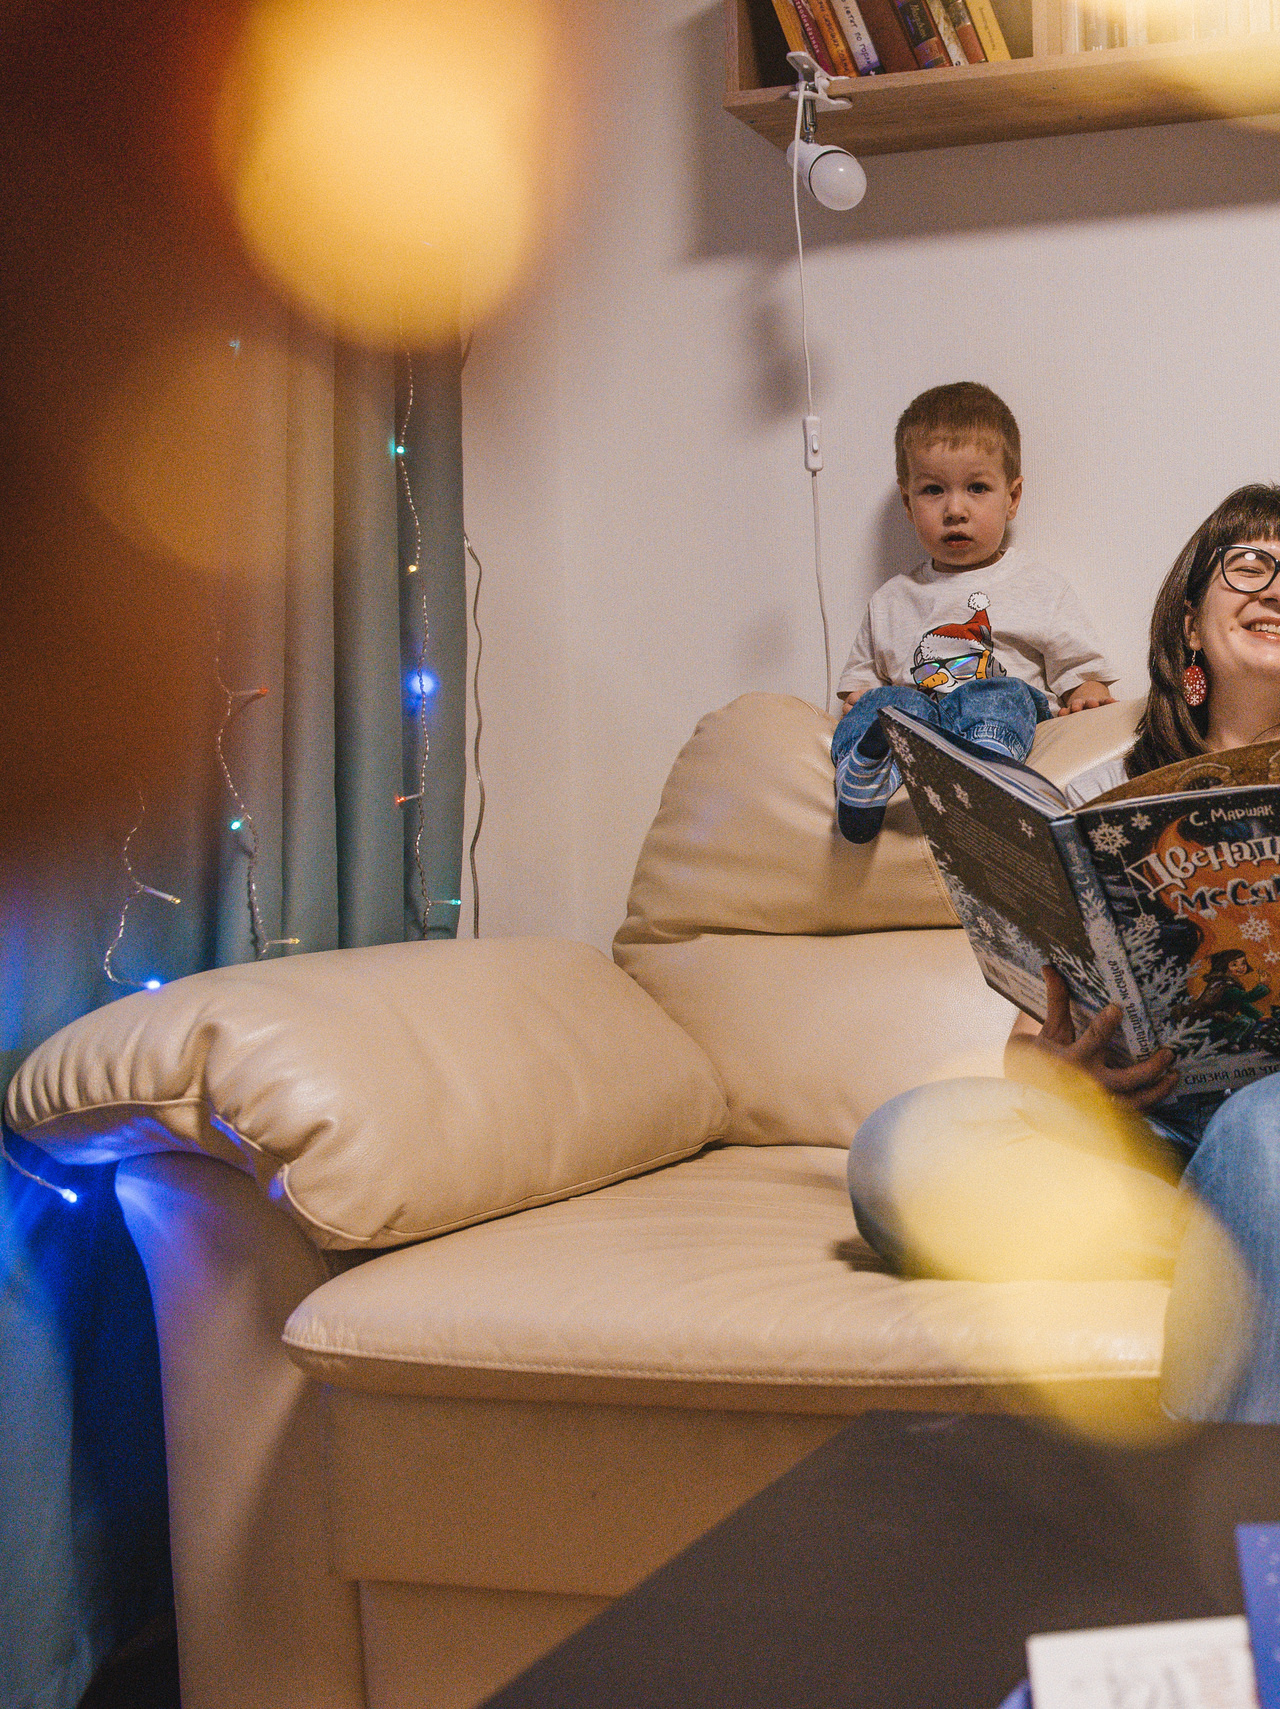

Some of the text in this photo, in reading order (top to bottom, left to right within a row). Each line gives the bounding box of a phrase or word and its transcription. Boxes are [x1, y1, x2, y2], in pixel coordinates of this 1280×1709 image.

[1189, 811, 1209, 827] С.
[1184, 1071, 1229, 1085] СКАЗКА
[1233, 1067, 1256, 1080] ДЛЯ
